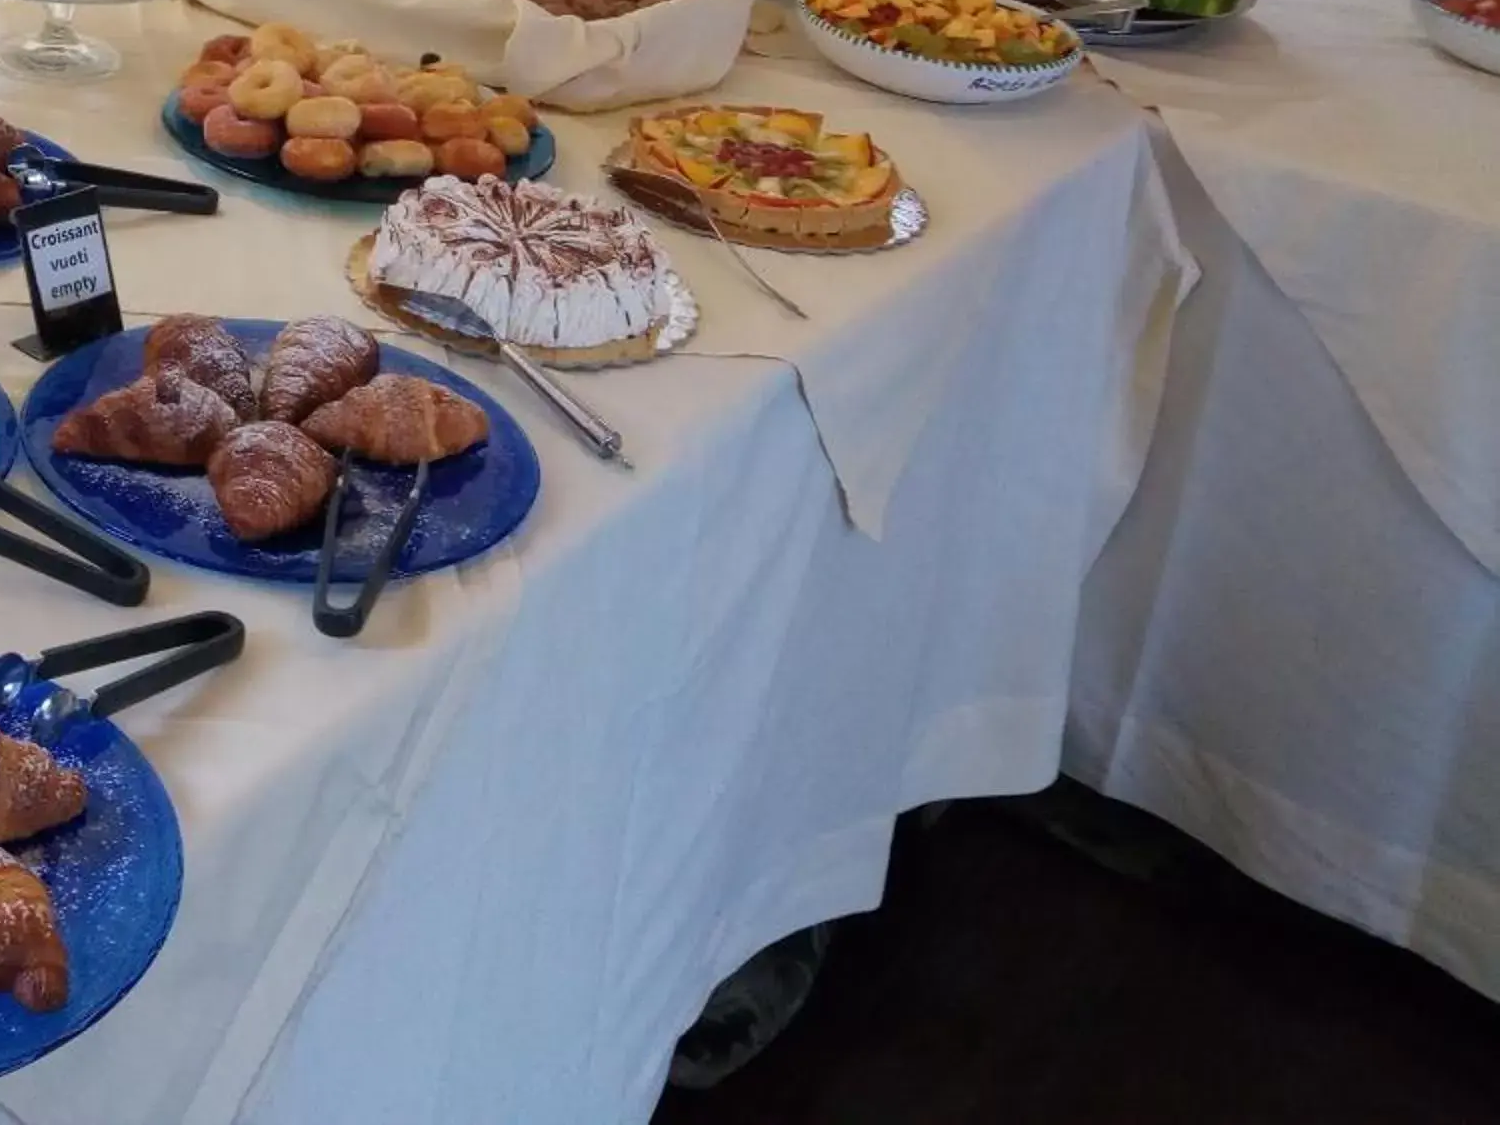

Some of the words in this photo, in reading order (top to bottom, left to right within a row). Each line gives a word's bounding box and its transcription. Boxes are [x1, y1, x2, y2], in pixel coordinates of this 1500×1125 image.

[31, 220, 99, 250] Croissant
[49, 246, 89, 272] vuoti
[50, 275, 97, 299] empty
